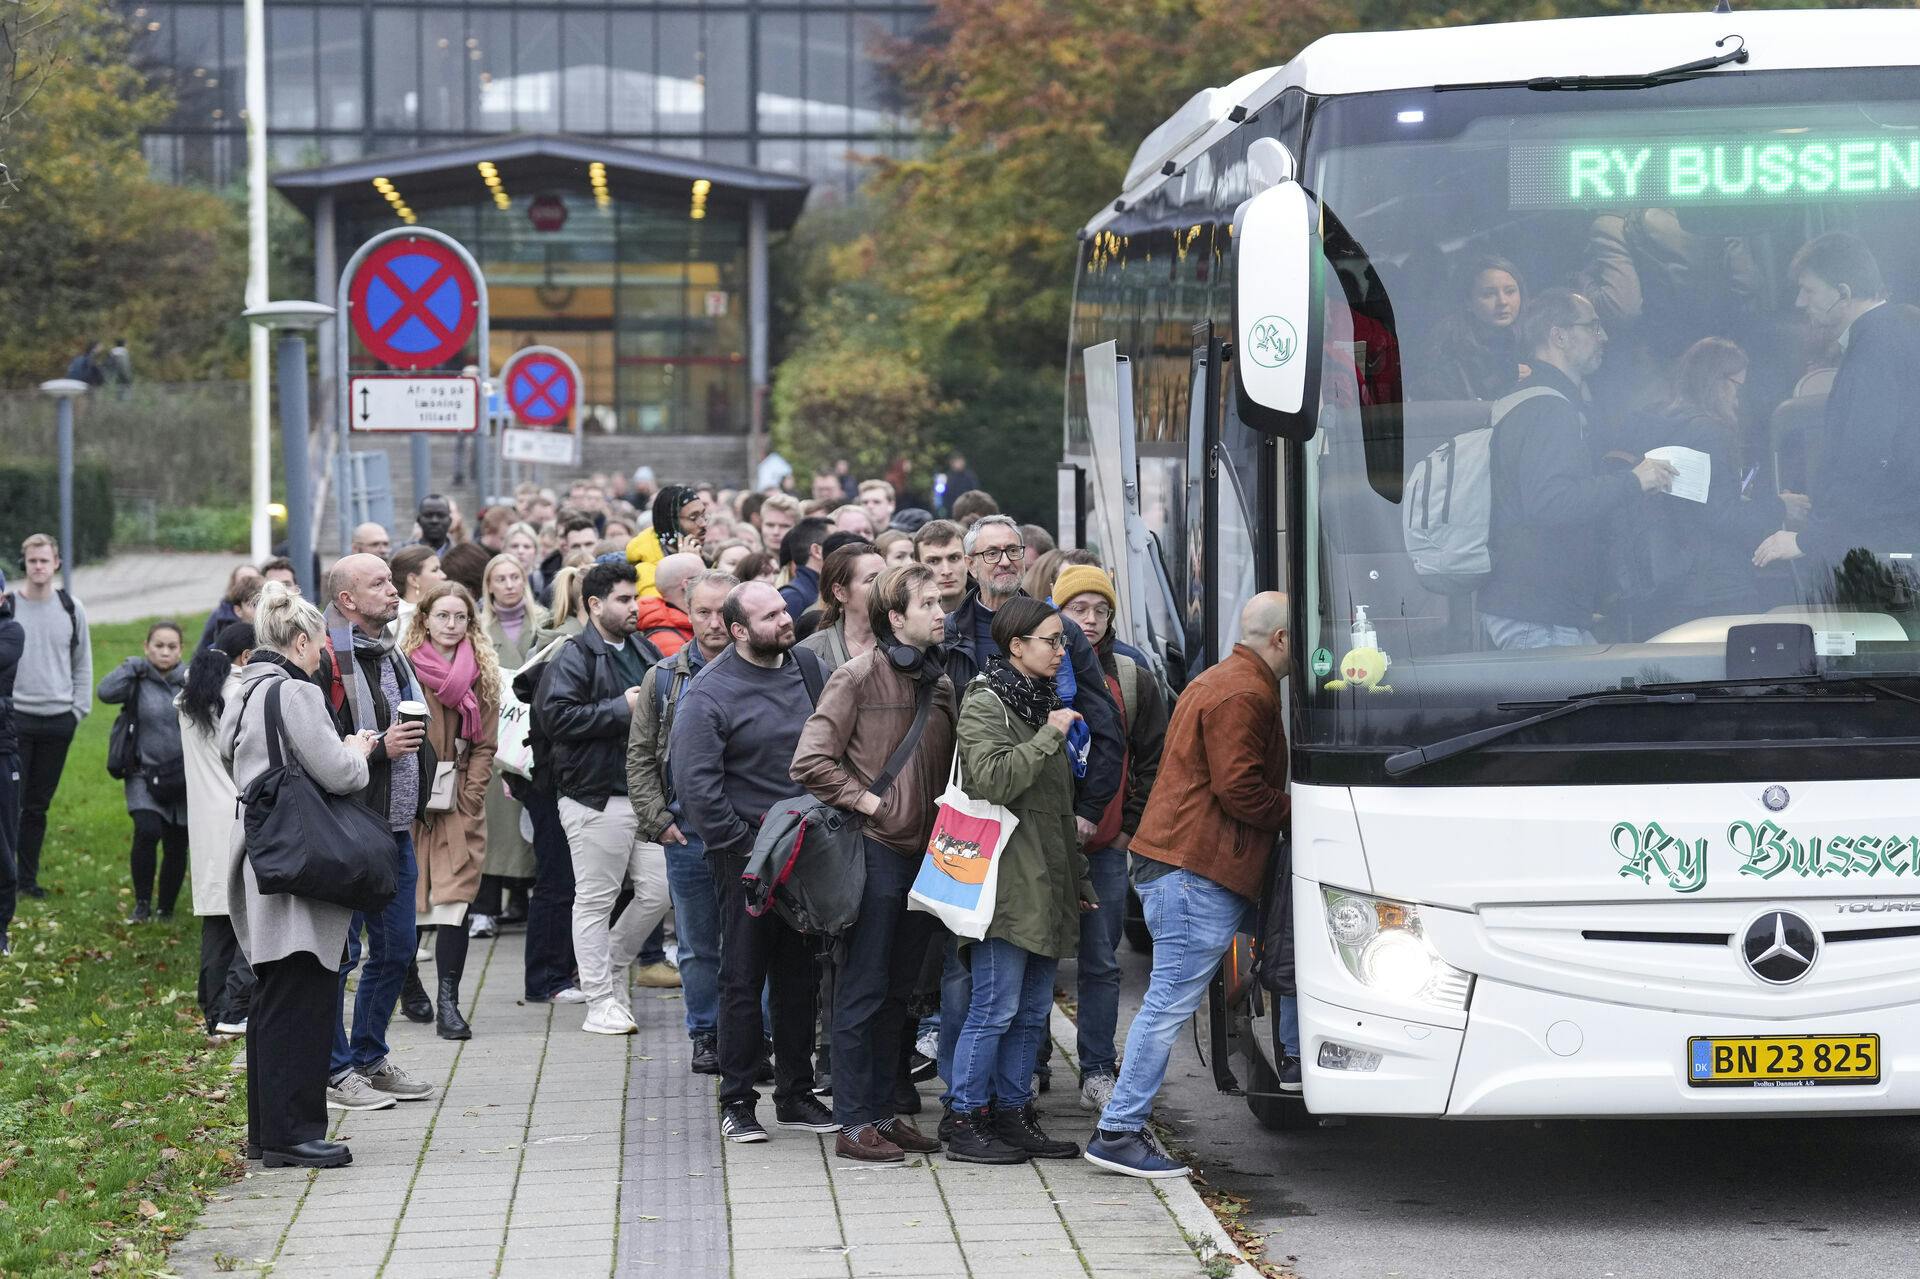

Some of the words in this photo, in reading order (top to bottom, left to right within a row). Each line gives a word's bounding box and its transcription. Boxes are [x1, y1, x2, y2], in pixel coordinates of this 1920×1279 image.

[1570, 147, 1650, 198] RY
[1668, 141, 1920, 194] BUSSEN
[1255, 324, 1291, 361] Ry
[431, 387, 445, 396] og
[419, 412, 458, 421] tilladt
[1318, 649, 1325, 662] 4
[1610, 821, 1708, 893] Ry
[1695, 1063, 1707, 1072] DK
[1715, 1045, 1757, 1073] BN
[1766, 1045, 1804, 1073] 23
[1813, 1043, 1872, 1072] 825
